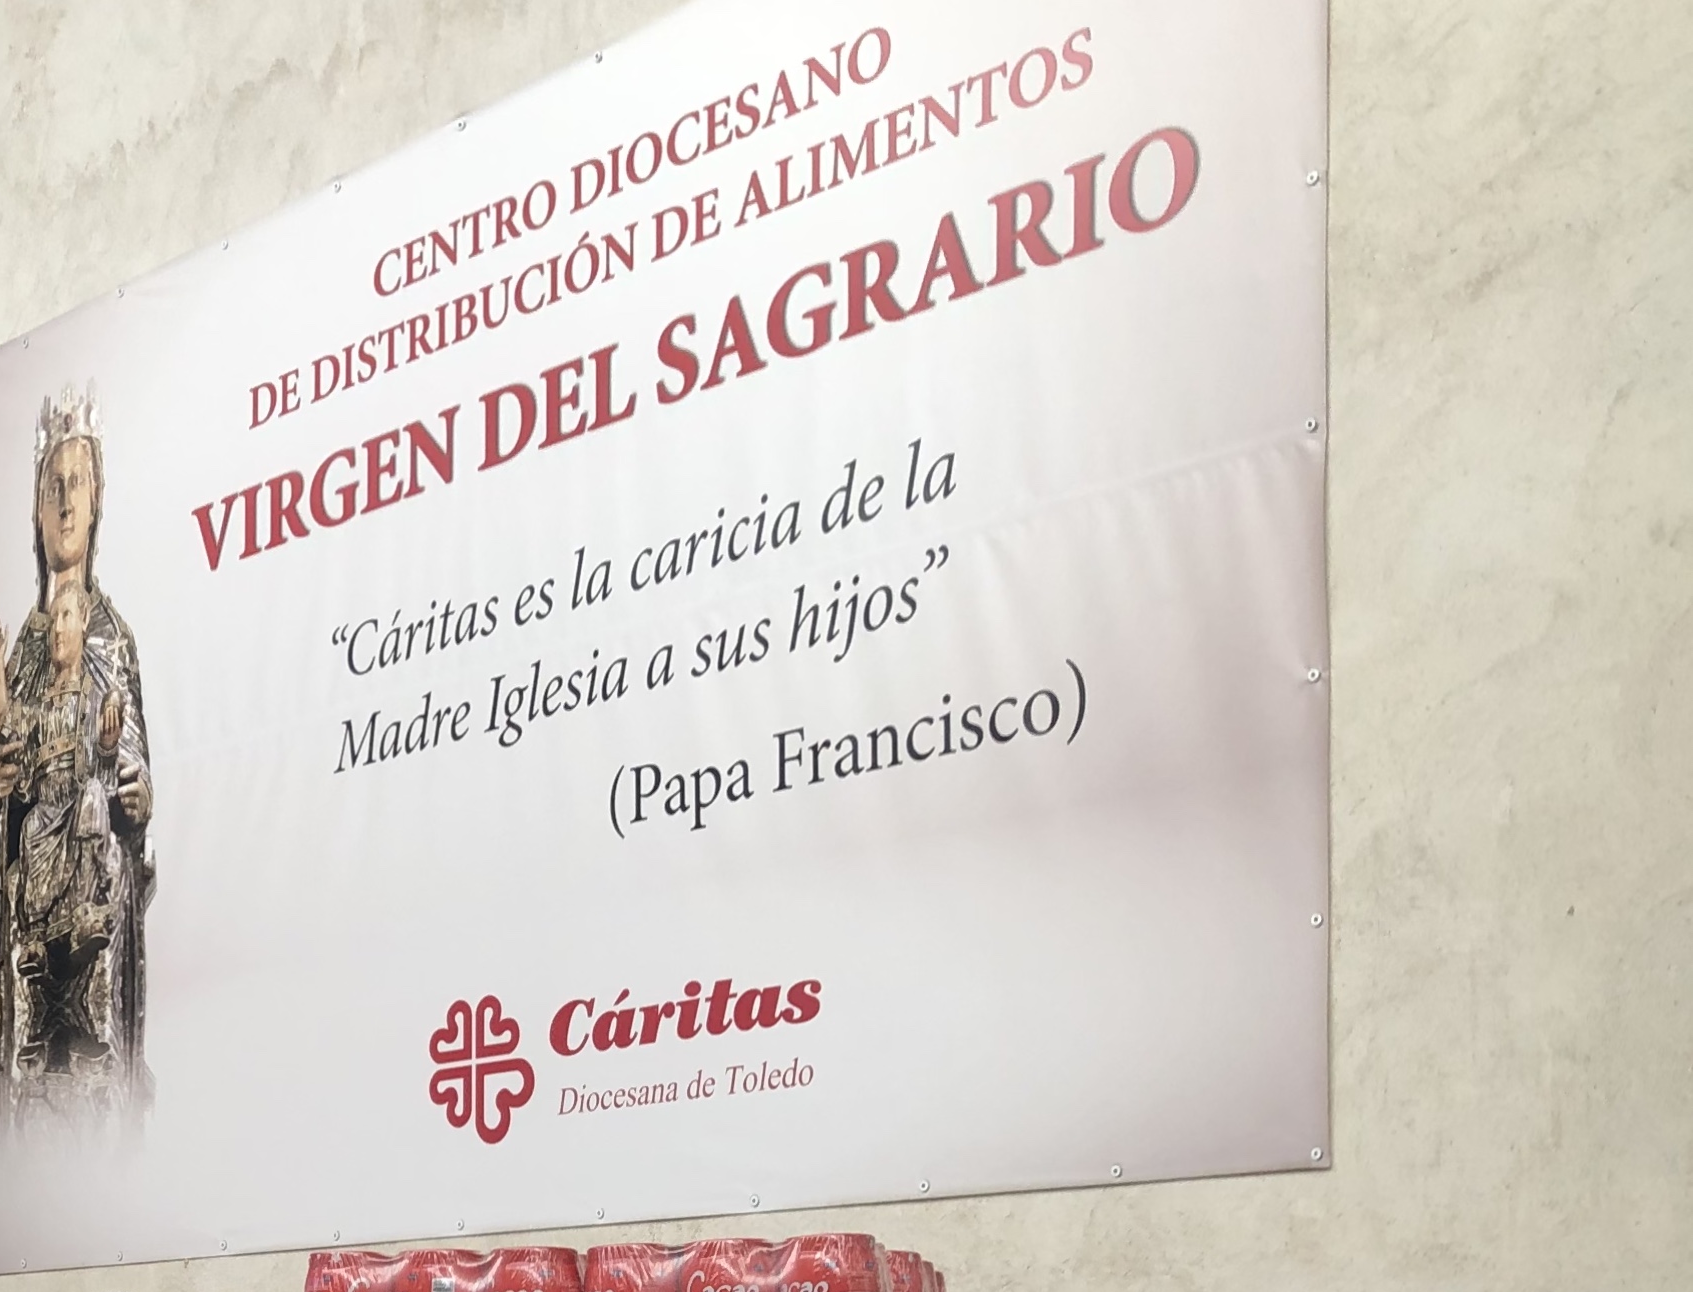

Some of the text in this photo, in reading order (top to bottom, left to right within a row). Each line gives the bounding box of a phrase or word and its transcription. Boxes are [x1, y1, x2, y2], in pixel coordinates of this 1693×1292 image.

[249, 27, 1093, 430] DE DISTRIBUCIÓN DE ALIMENTOS
[374, 27, 891, 297] CENTRO DIOCESANO
[191, 126, 1201, 572] VIRGEN DEL SAGRARIO
[514, 578, 555, 628] es
[571, 546, 612, 610] la
[630, 500, 801, 592] caricia
[821, 459, 884, 534] de
[905, 437, 956, 510] la
[333, 691, 471, 774] Madre
[484, 657, 628, 748] Iglesia
[647, 644, 674, 690] a
[691, 618, 771, 678] sus
[610, 658, 1086, 839] (Papa Francisco)
[549, 978, 822, 1057] Cáritas
[558, 1057, 813, 1115] Diocesana de Toledo
